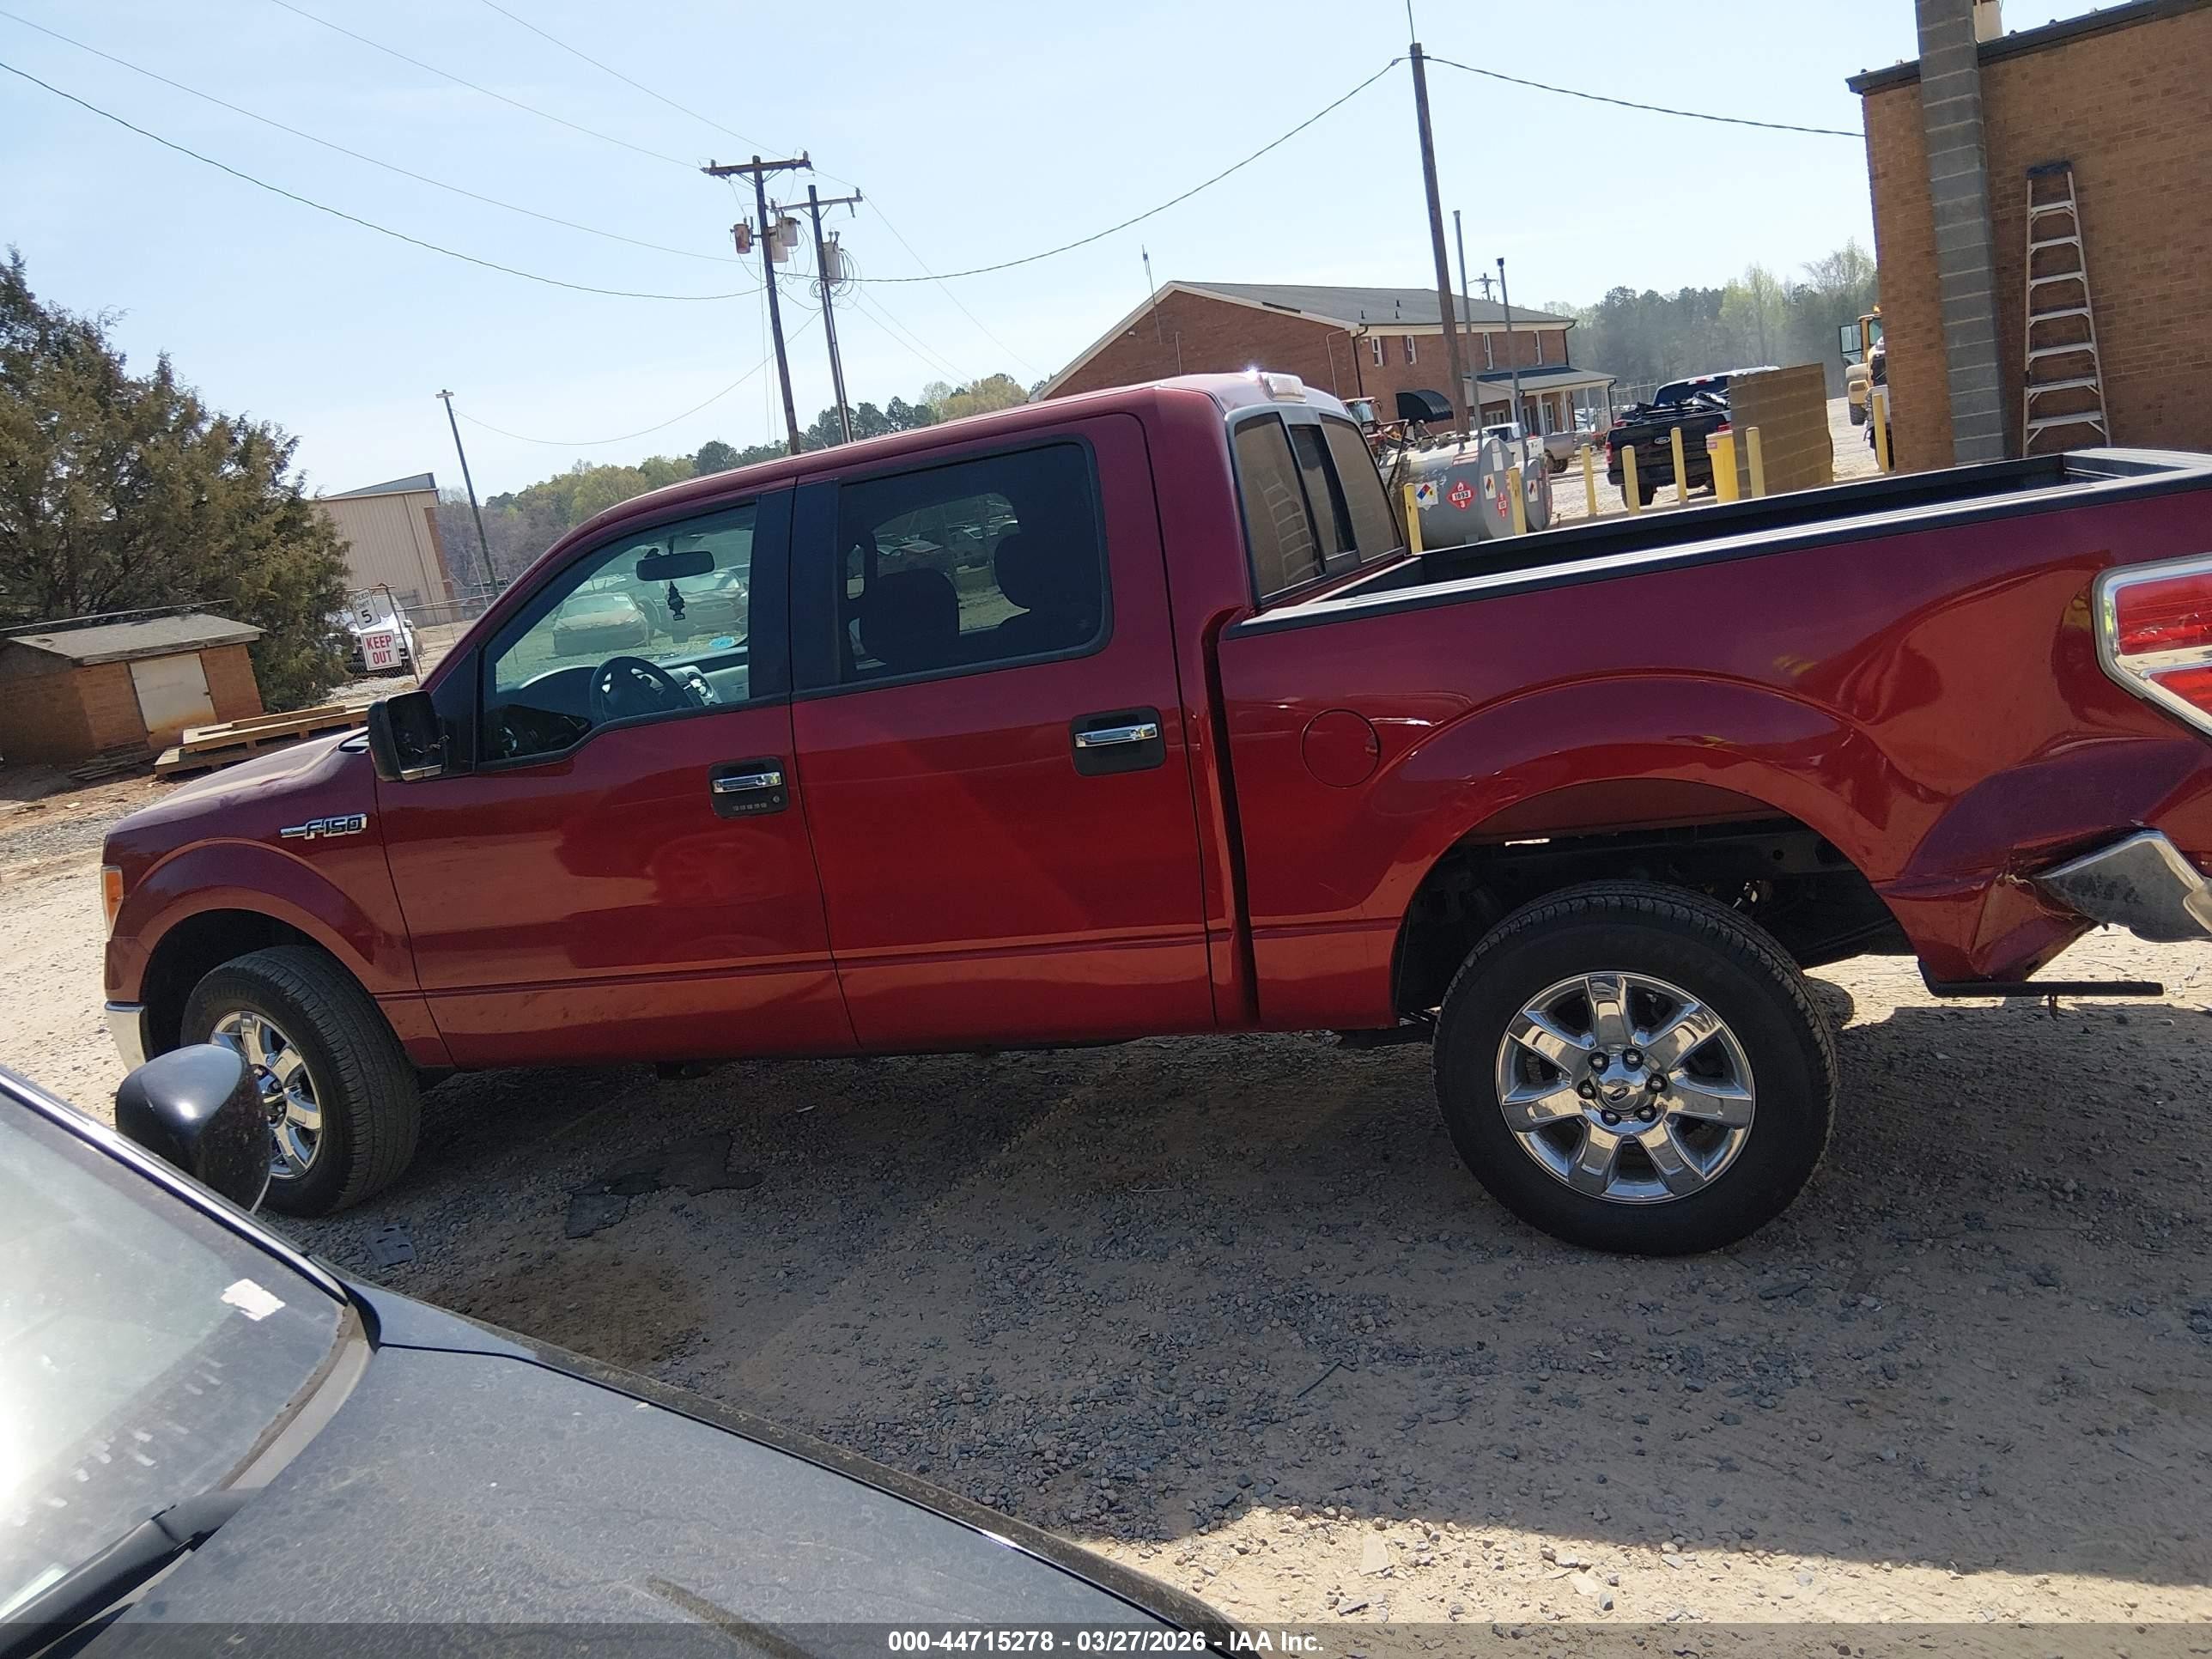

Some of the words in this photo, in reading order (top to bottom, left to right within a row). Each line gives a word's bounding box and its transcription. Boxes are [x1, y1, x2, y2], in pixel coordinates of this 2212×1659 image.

[361, 610, 373, 623] 5
[366, 635, 392, 650] KEEP
[372, 650, 392, 665] OUT
